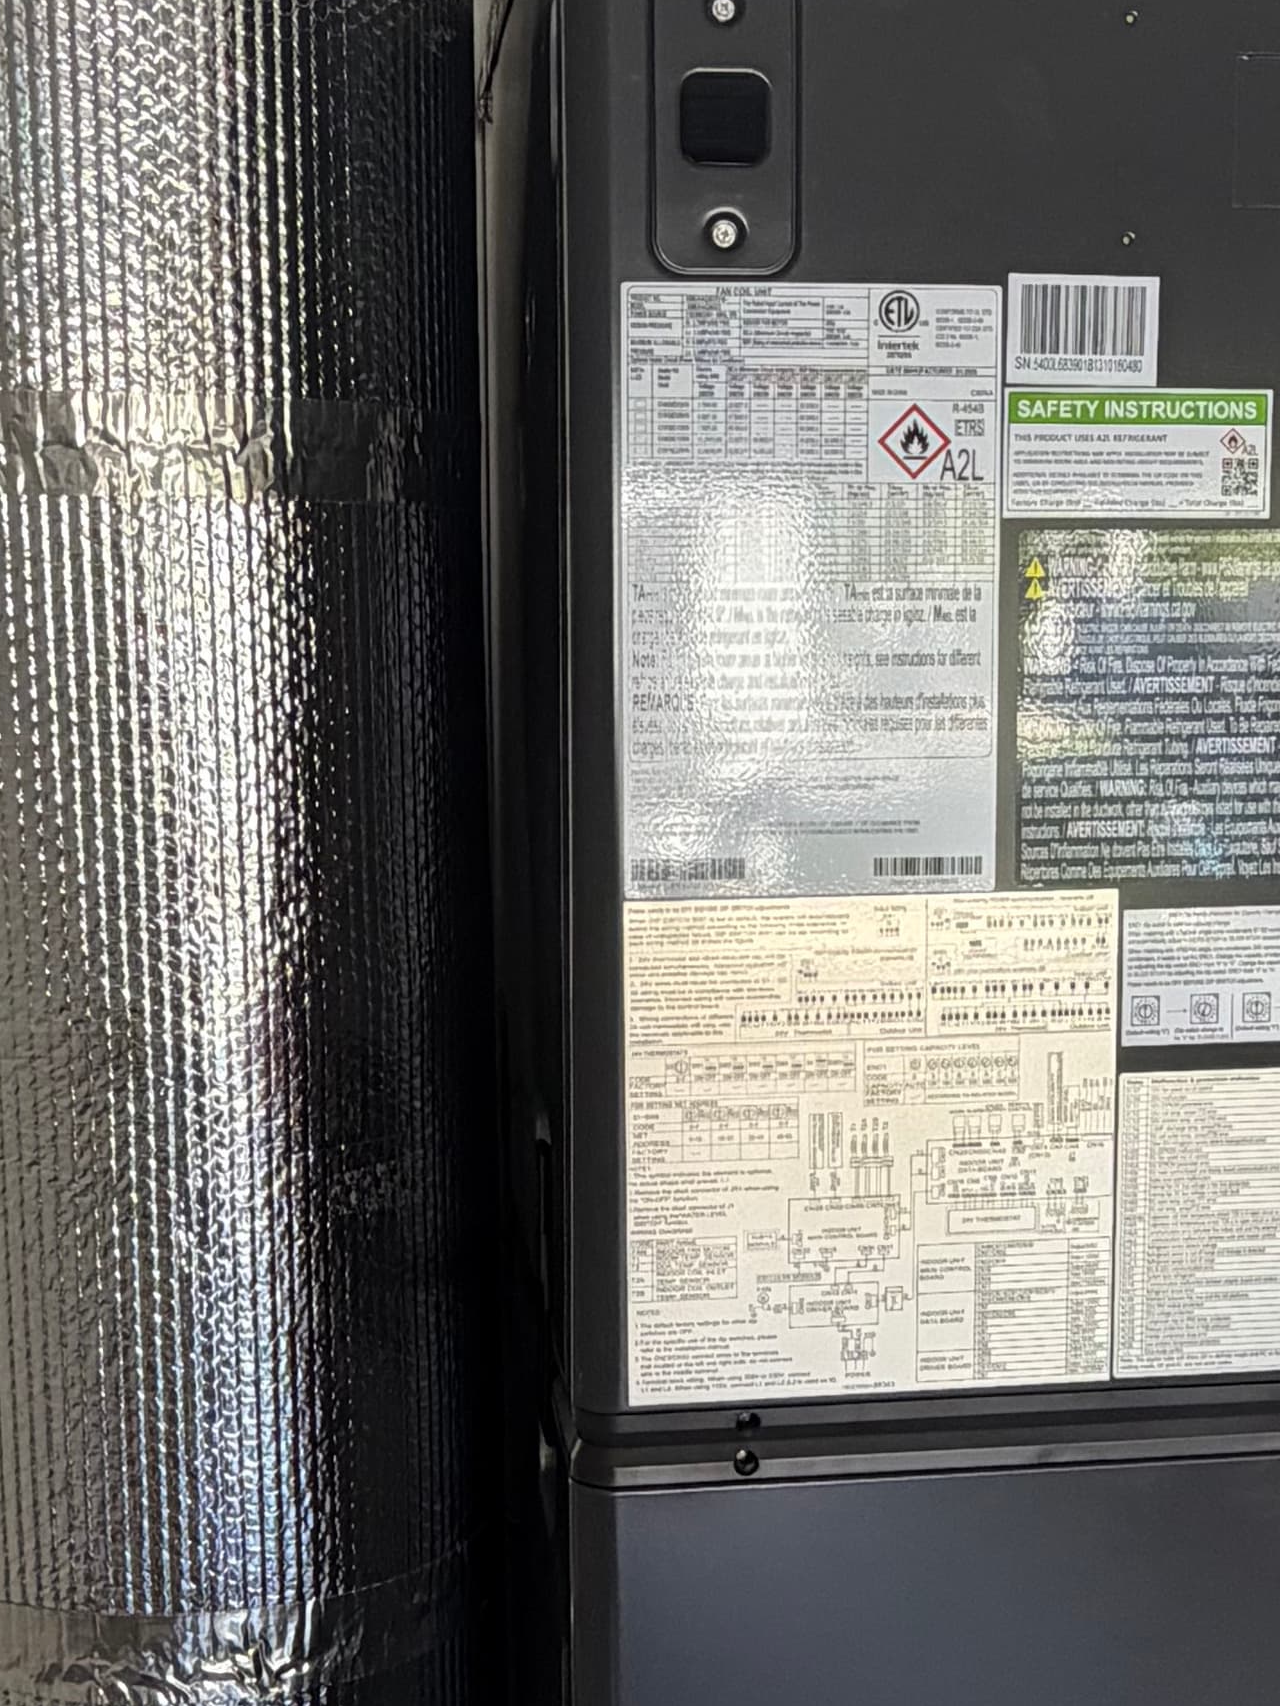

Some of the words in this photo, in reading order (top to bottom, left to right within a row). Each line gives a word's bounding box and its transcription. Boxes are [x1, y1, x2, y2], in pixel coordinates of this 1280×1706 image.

[884, 296, 915, 328] ETL
[877, 340, 921, 351] Intertek
[1017, 399, 1099, 419] SAFETY
[1104, 400, 1258, 421] INSTRUCTIONS
[1014, 433, 1032, 442] THIS
[1033, 433, 1072, 442] PRODUCT
[1113, 434, 1168, 443] REFRIGERANT
[940, 449, 984, 481] A2L
[1133, 676, 1214, 694] AVERTISSEMENT
[1196, 736, 1277, 755] AVERTISSEMENT
[1099, 779, 1148, 797] WARNING:
[1066, 820, 1146, 839] AVERTISSEMENT:
